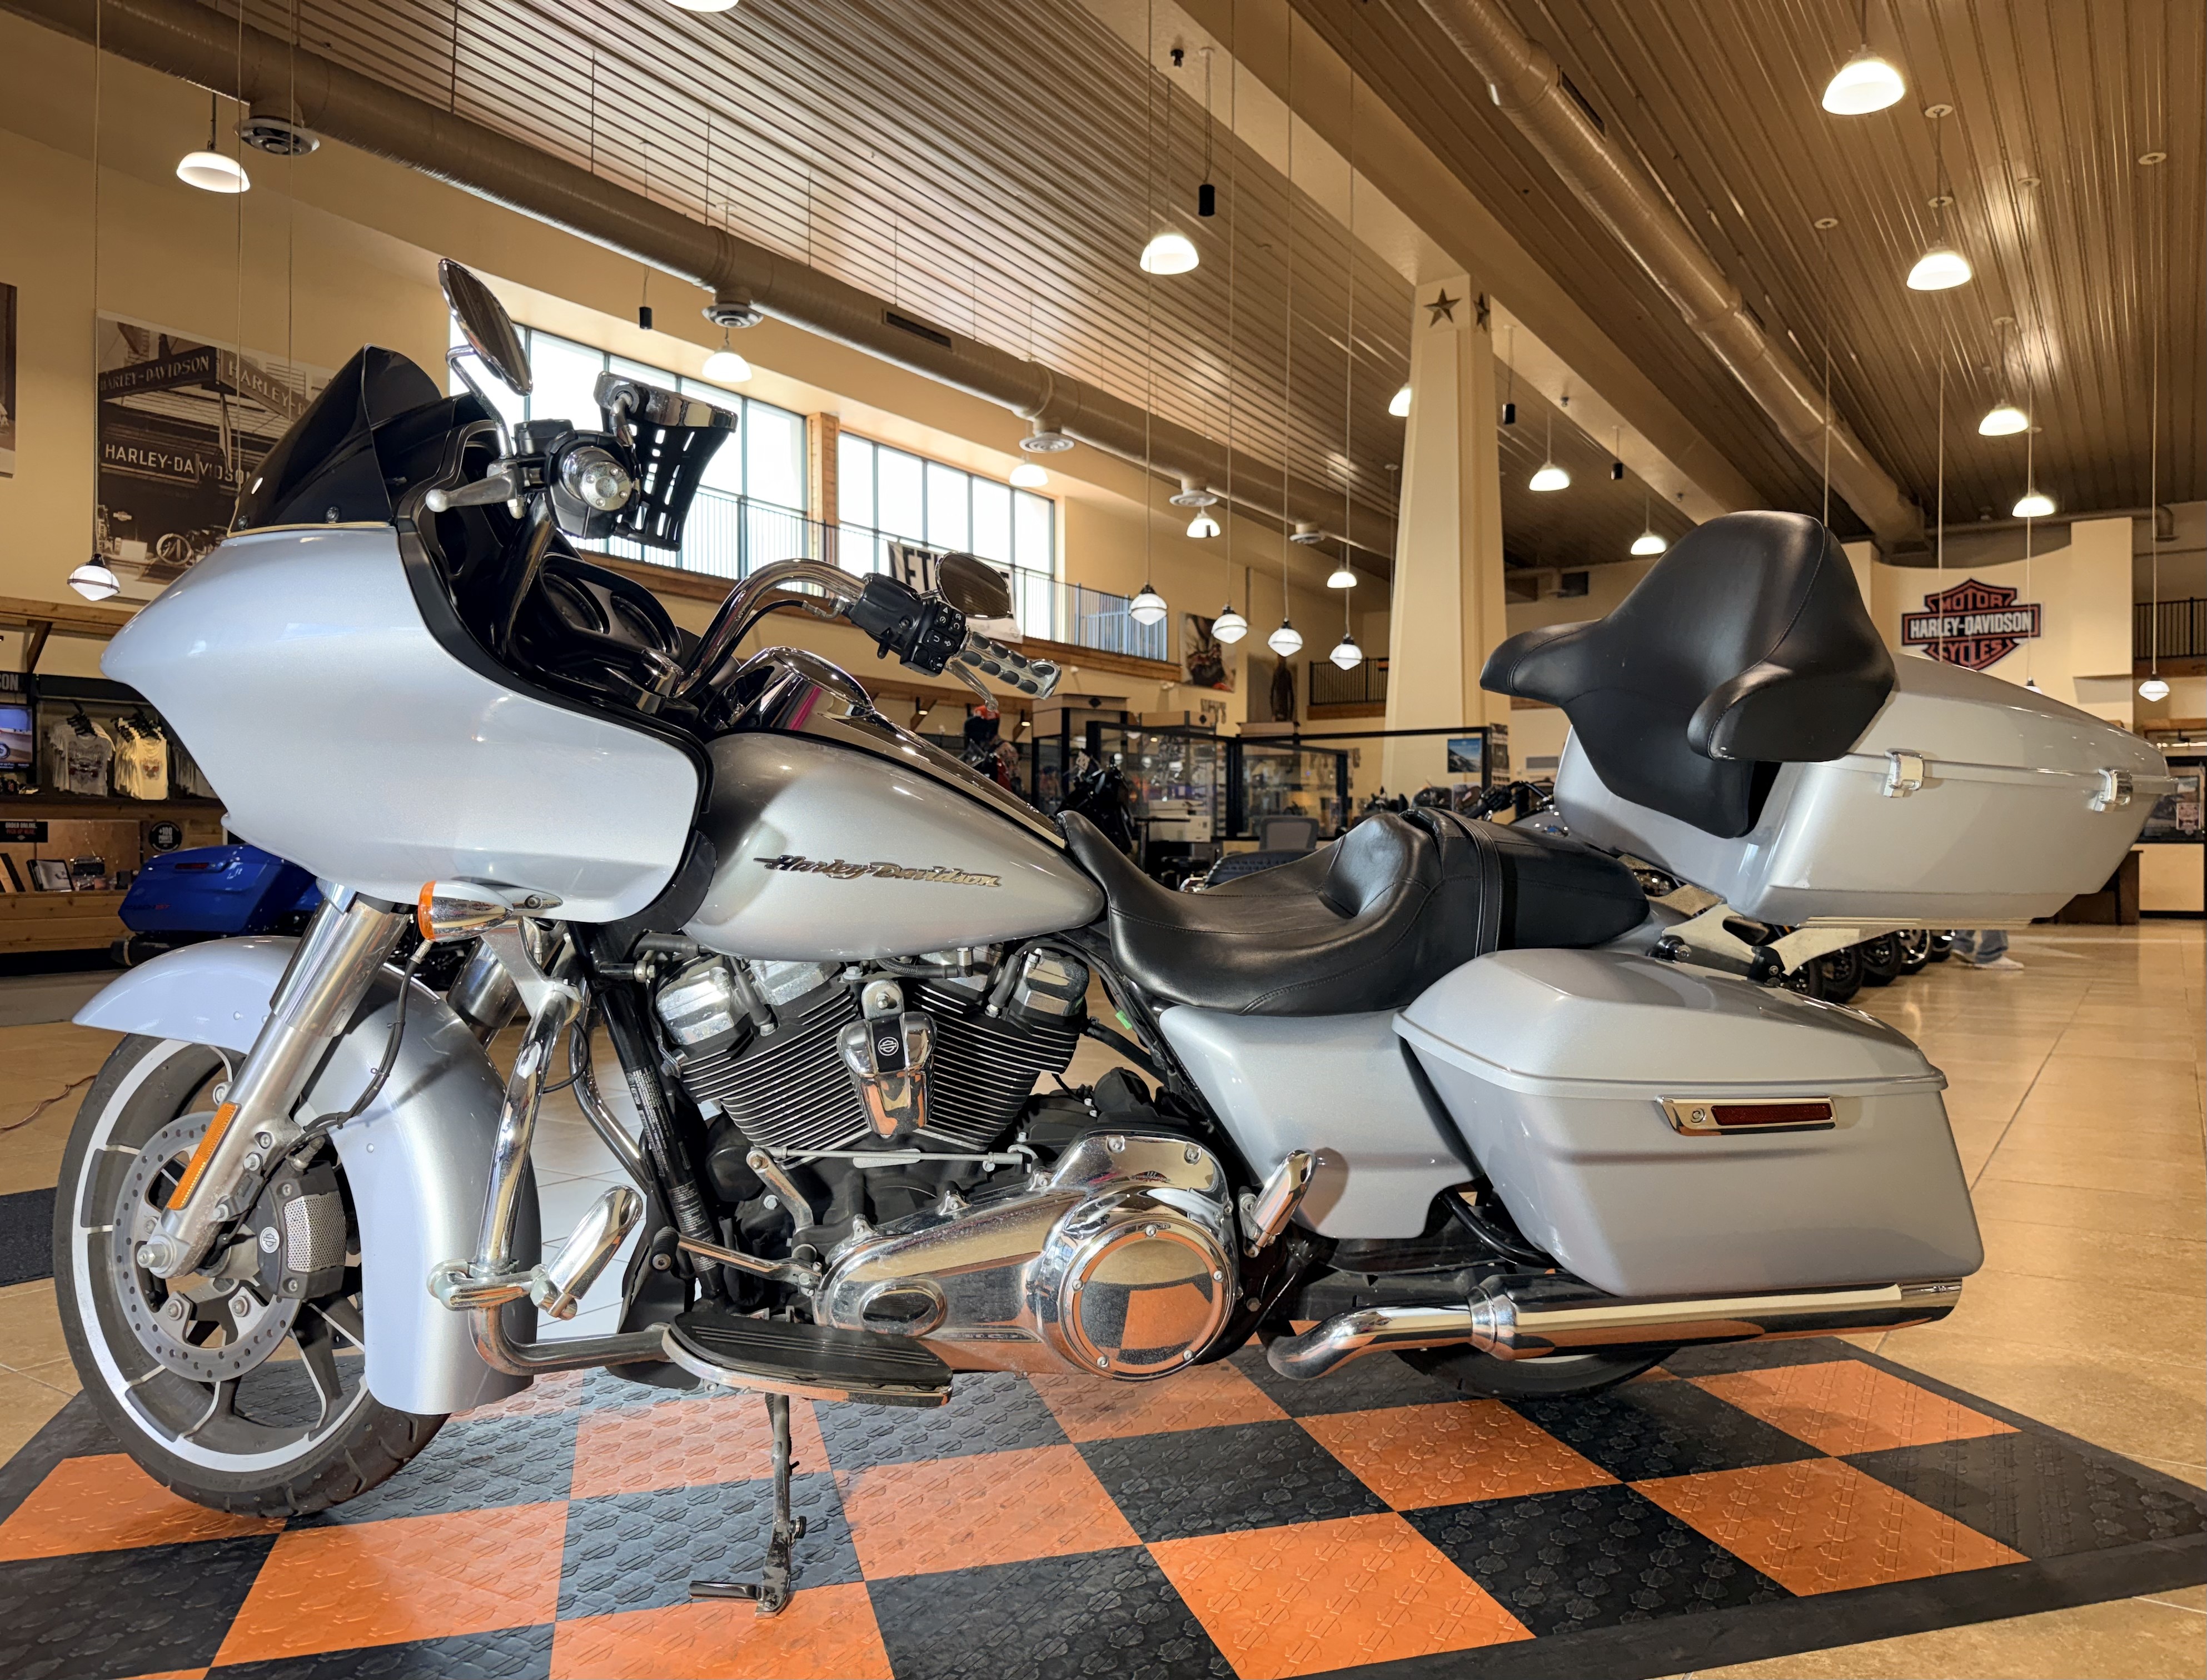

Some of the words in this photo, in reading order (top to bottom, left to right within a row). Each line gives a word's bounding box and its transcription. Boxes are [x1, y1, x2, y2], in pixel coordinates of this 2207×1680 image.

[1941, 587, 2004, 611] MOTOR
[1910, 611, 2032, 639] HARLEY-DAVIDSON
[1941, 640, 2004, 666] CYCLES
[753, 855, 1002, 887] Harley-Davidson
